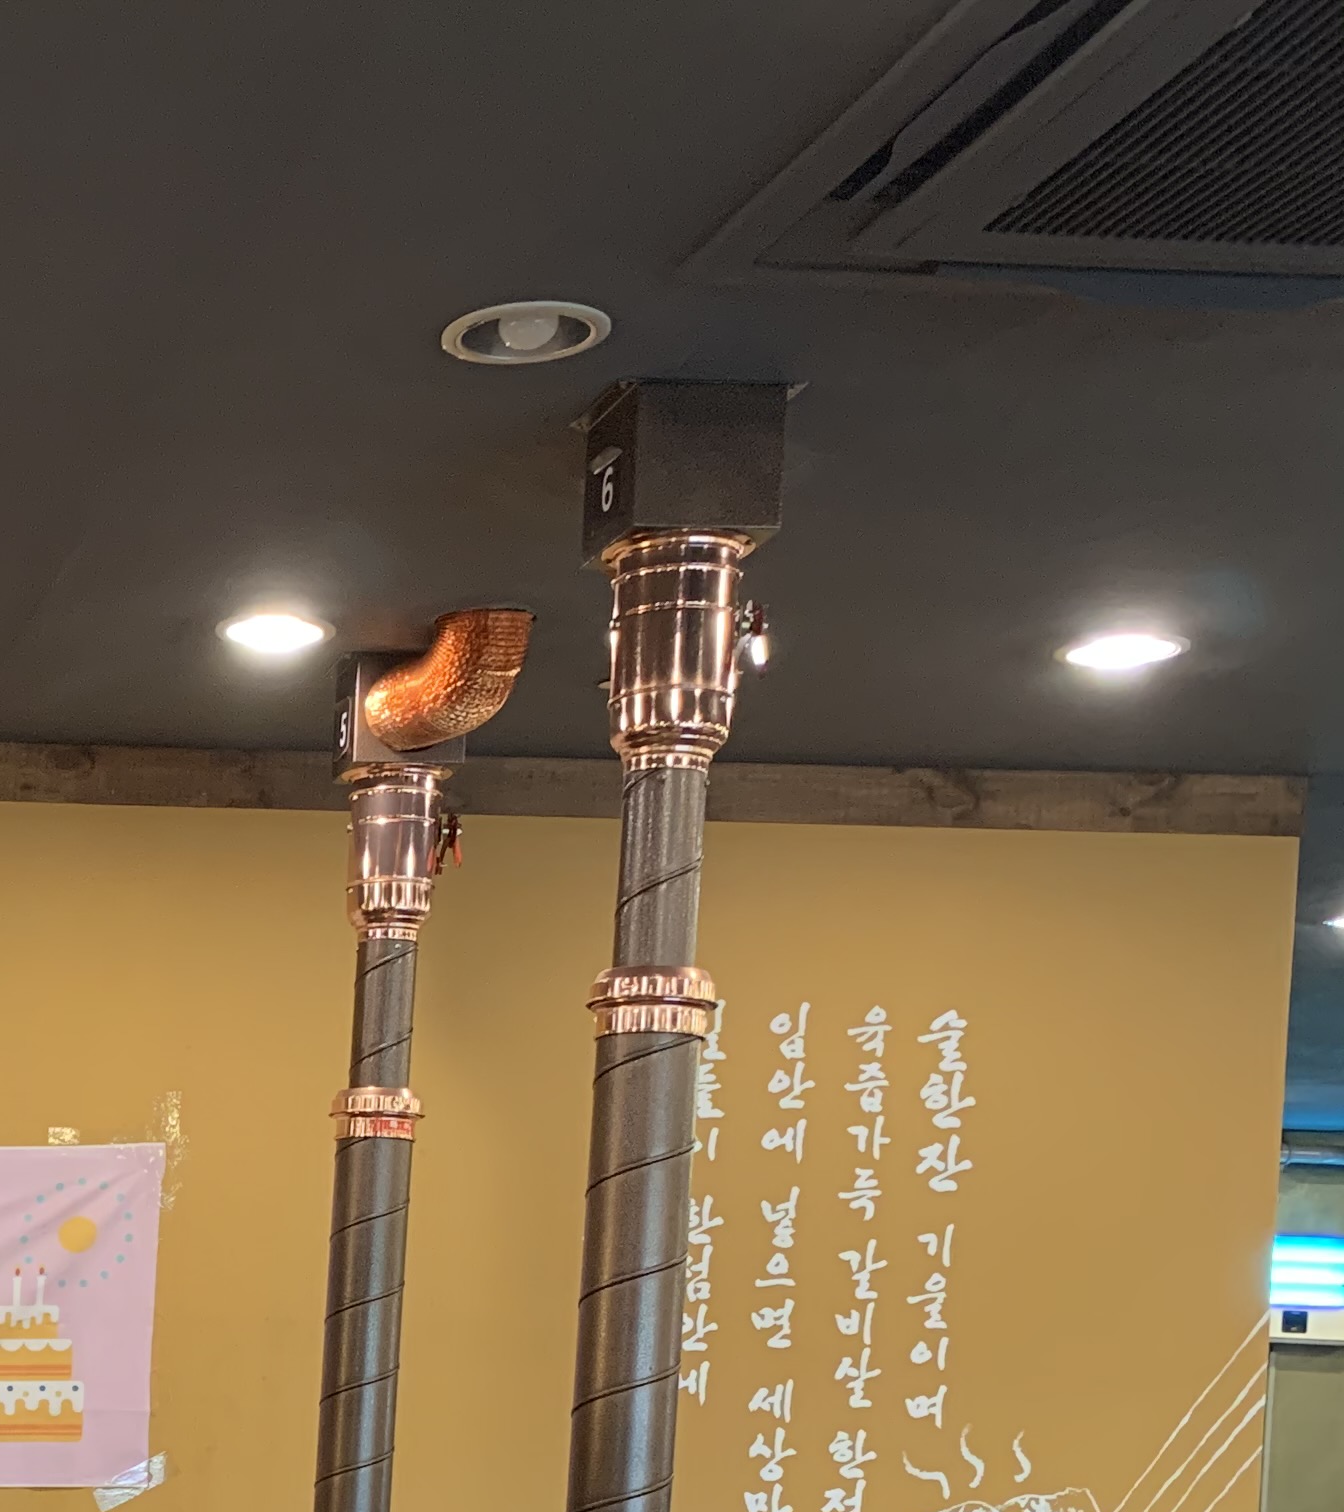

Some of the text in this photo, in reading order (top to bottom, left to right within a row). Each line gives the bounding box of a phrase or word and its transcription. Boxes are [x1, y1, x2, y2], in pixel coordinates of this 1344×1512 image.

[600, 467, 614, 513] 6
[338, 711, 348, 748] 5
[750, 1185, 800, 1348] 넣으면
[904, 1009, 977, 1429] 술한잔 기울이며
[833, 1238, 888, 1408] 갈비살
